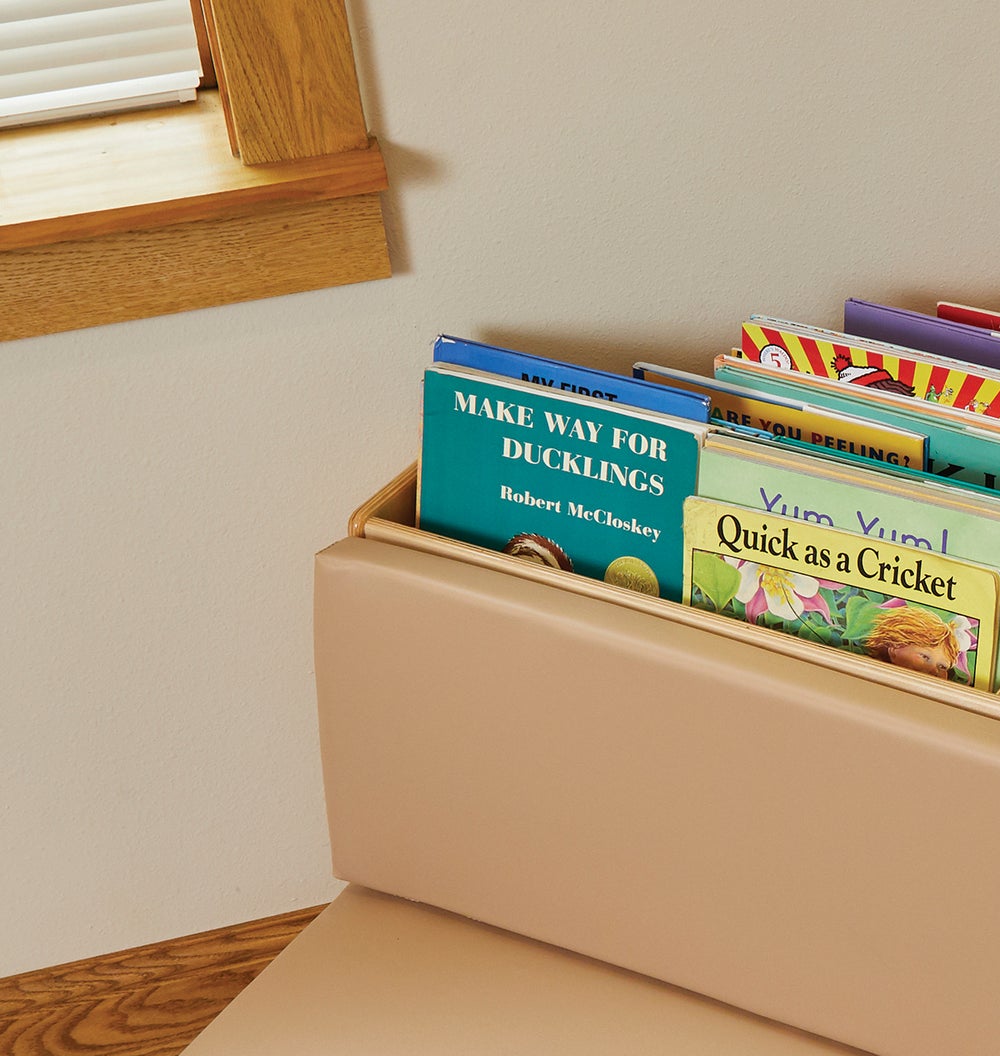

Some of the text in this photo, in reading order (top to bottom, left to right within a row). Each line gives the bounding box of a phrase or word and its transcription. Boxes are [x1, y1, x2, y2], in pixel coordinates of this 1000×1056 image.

[453, 390, 667, 462] MAKE WAY FOR
[710, 406, 752, 427] ARE
[759, 418, 802, 440] YOU
[502, 437, 665, 496] DUCKLINGS
[500, 484, 662, 543] Robert McCloskey
[717, 514, 957, 601] Quick as a Cricket
